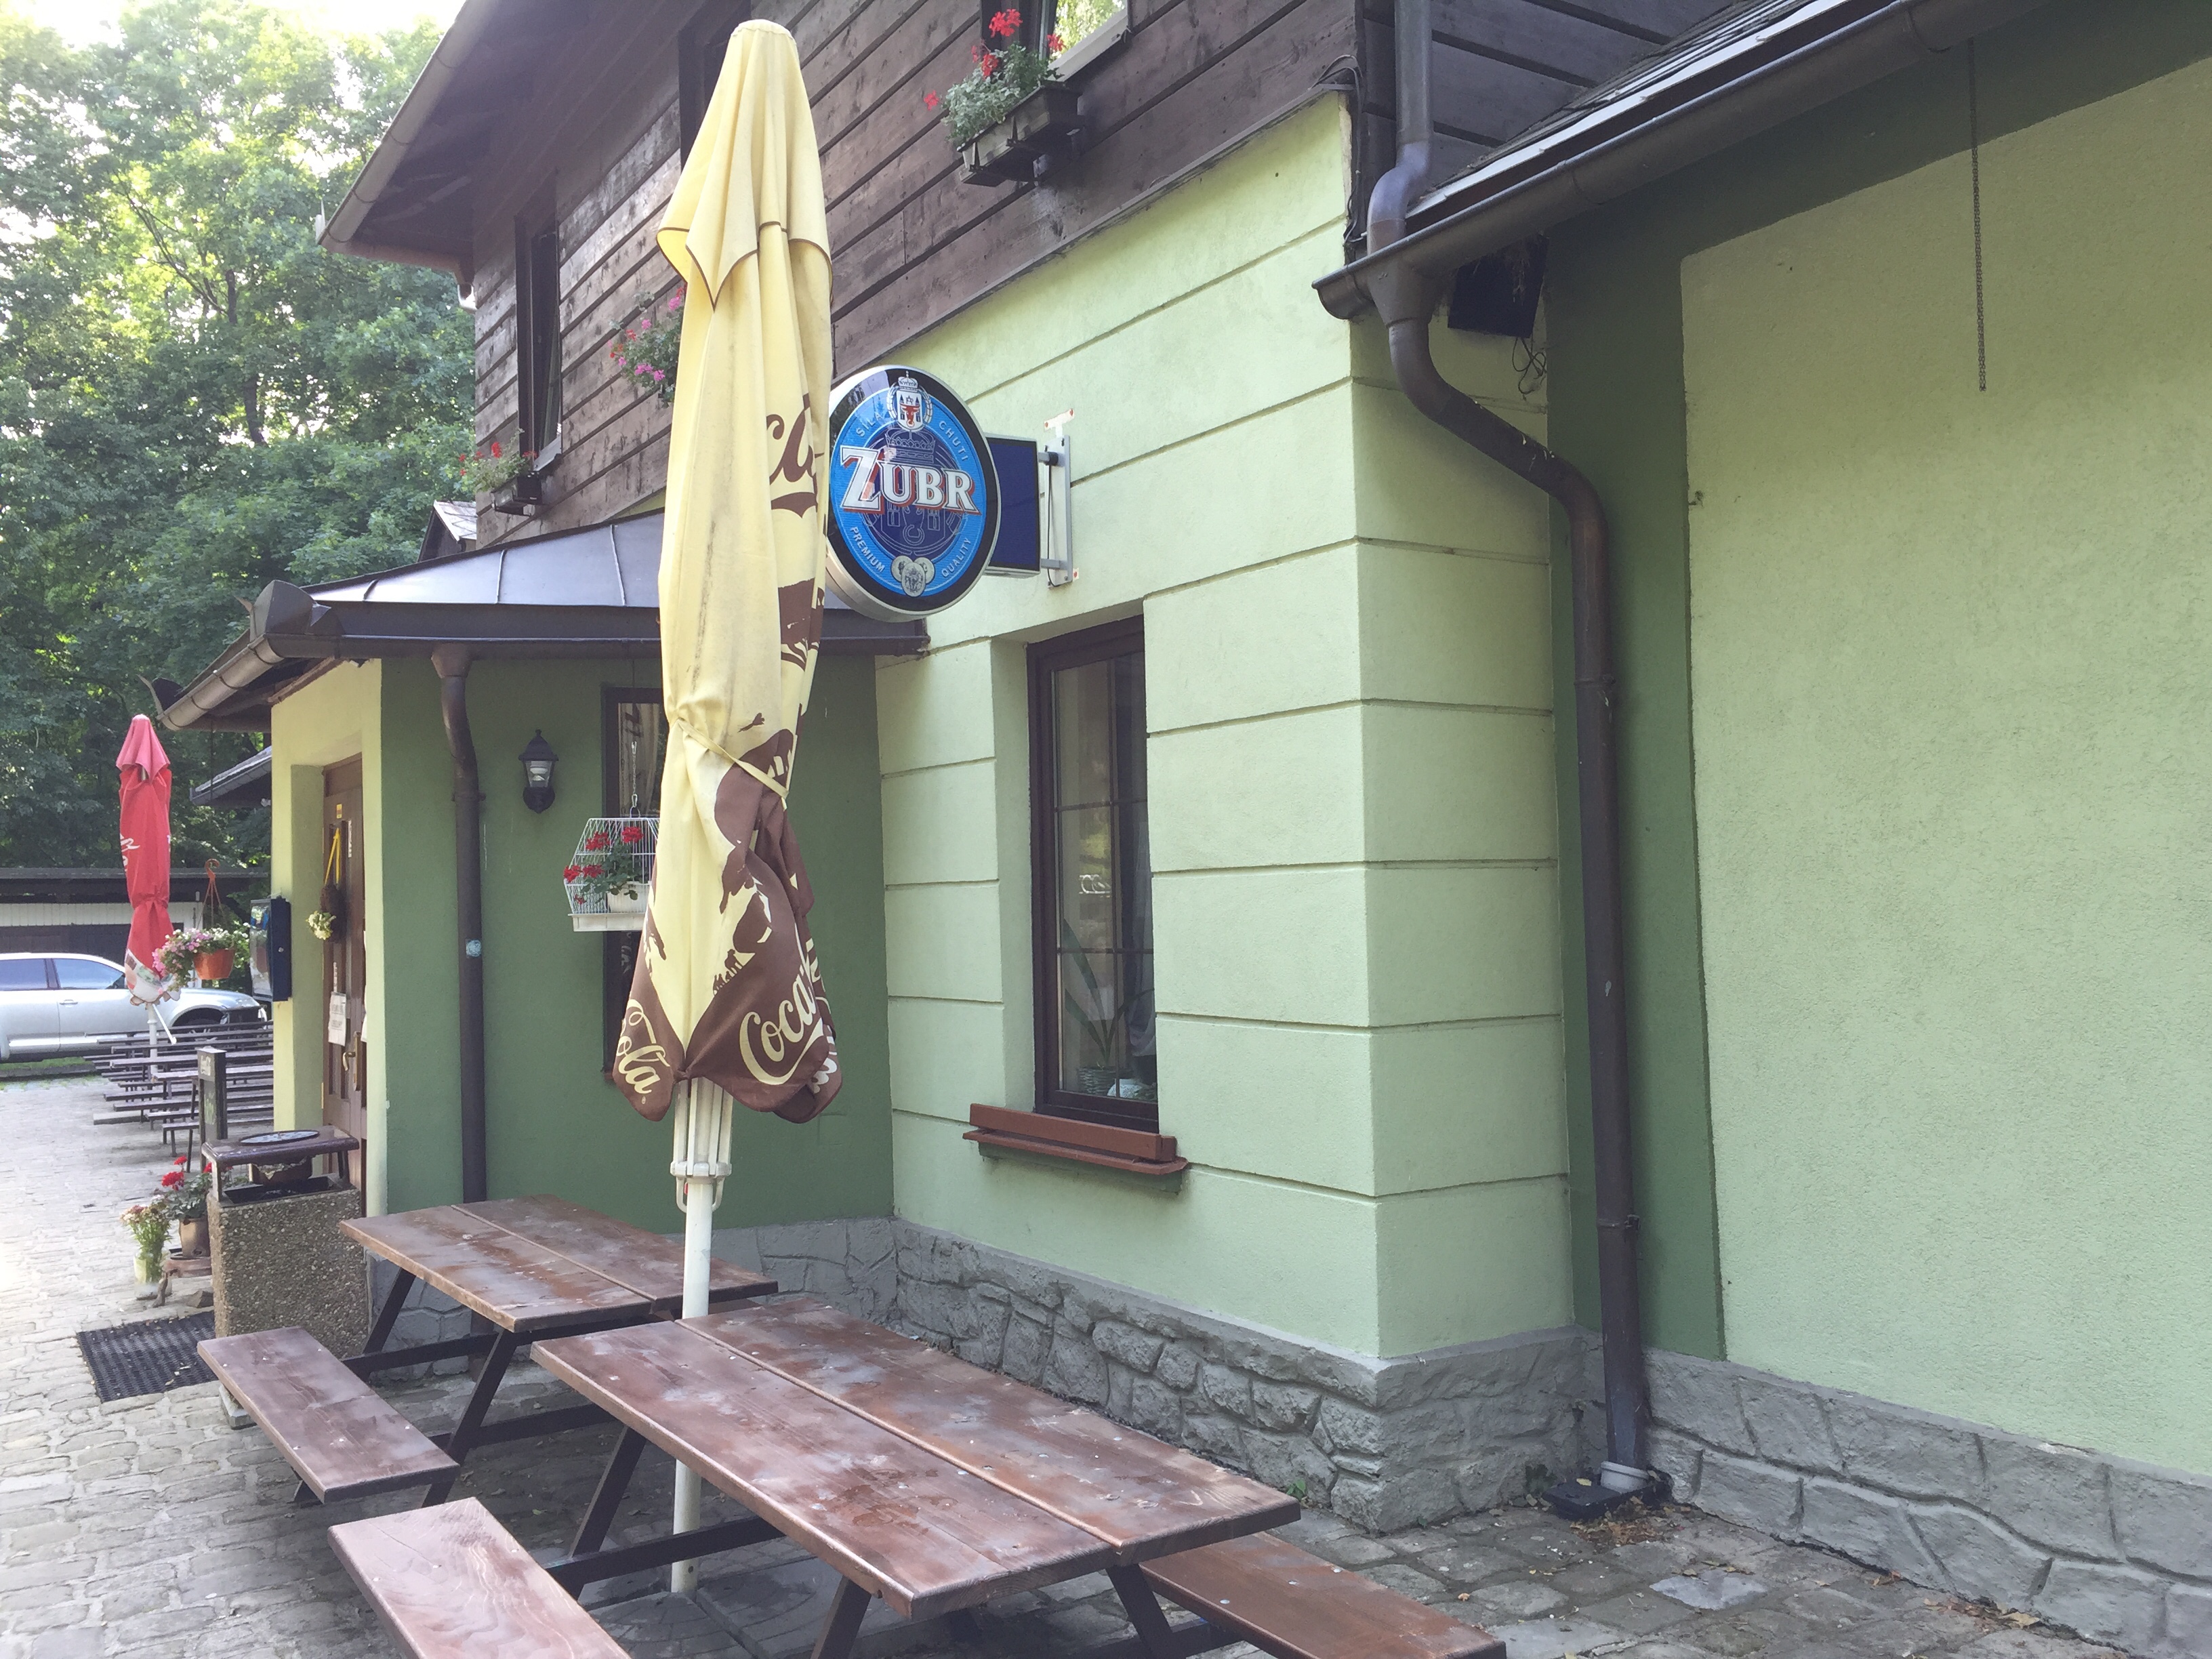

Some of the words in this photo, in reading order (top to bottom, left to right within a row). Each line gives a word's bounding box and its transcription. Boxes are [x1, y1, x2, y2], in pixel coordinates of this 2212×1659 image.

[939, 420, 968, 461] CHUTI
[840, 445, 980, 514] ZUBR
[850, 526, 886, 572] PREMIUM
[941, 537, 971, 577] QUALITY
